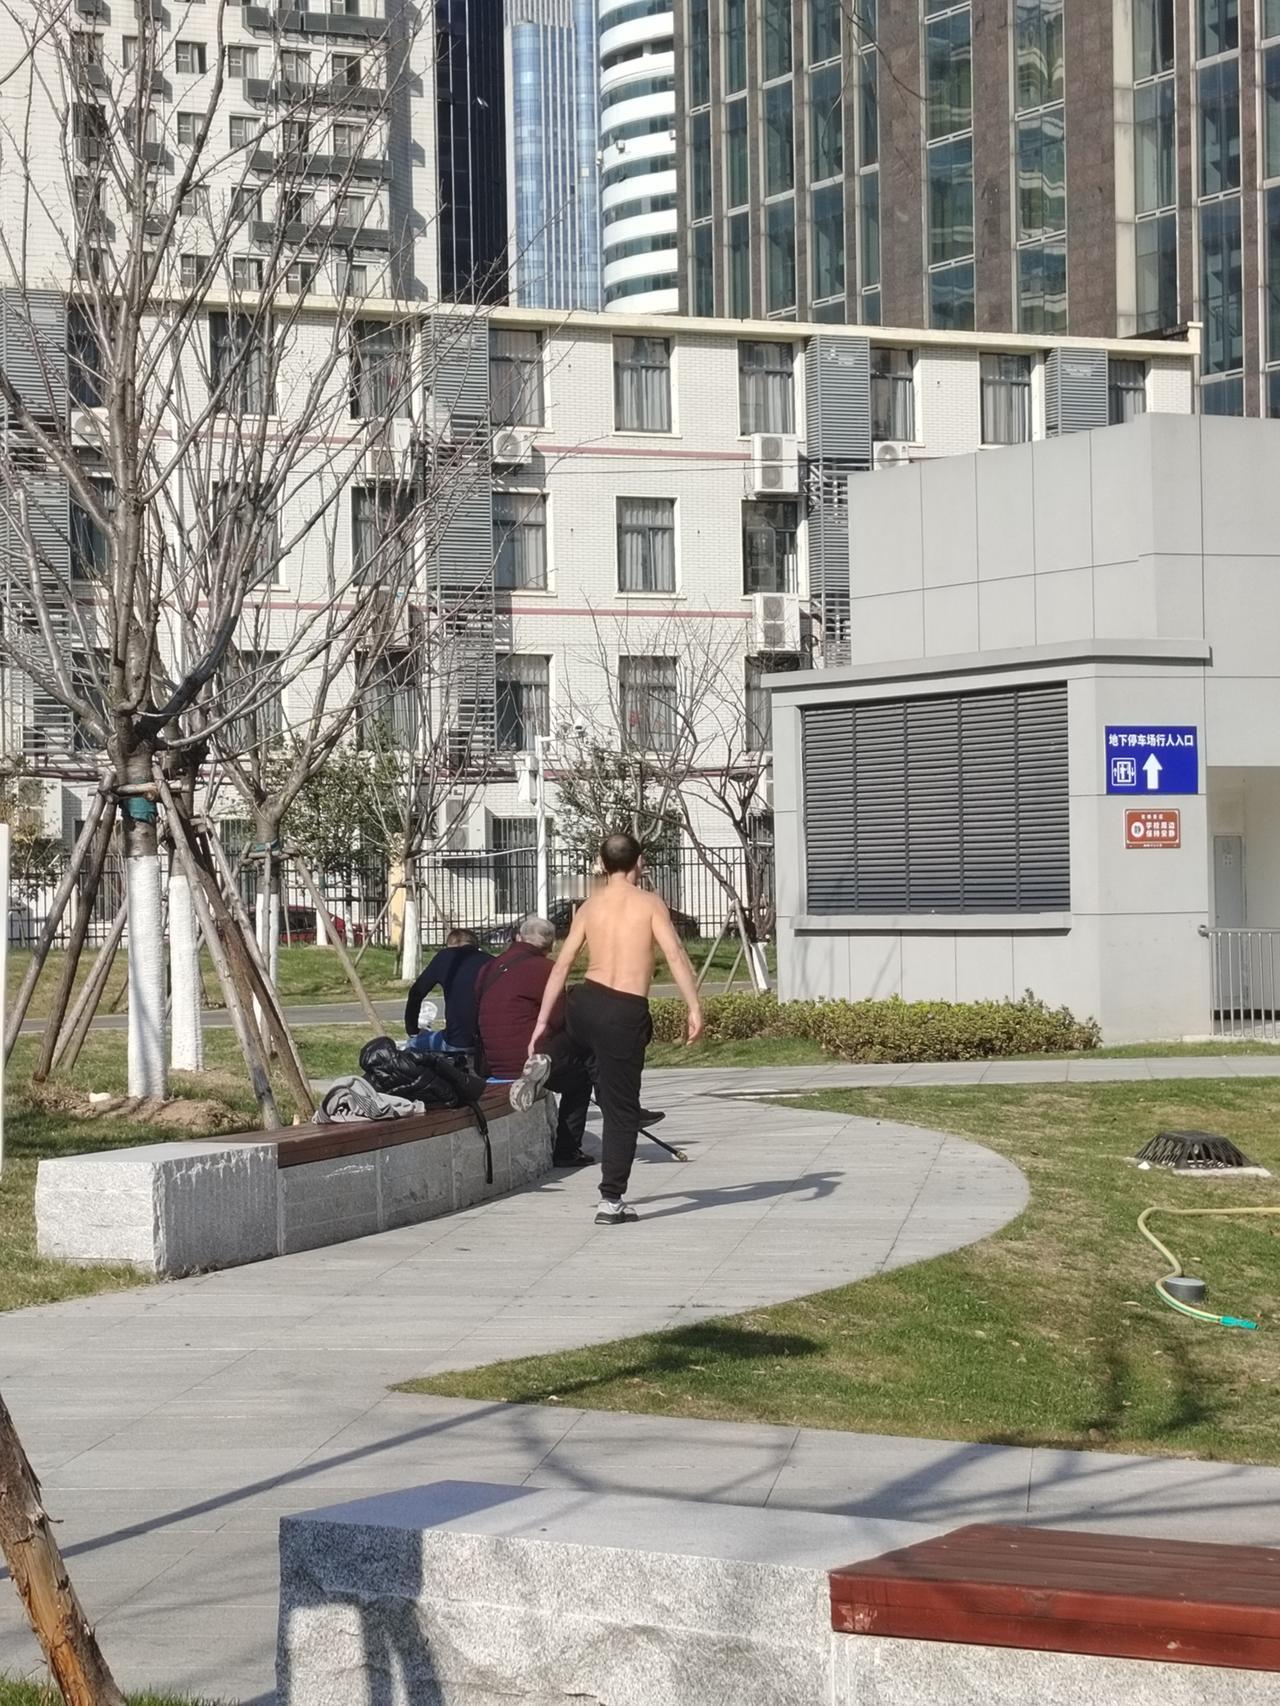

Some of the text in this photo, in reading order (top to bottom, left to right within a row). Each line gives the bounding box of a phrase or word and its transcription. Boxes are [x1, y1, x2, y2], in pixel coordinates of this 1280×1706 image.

[1108, 733, 1194, 747] 地下停车场行人入口
